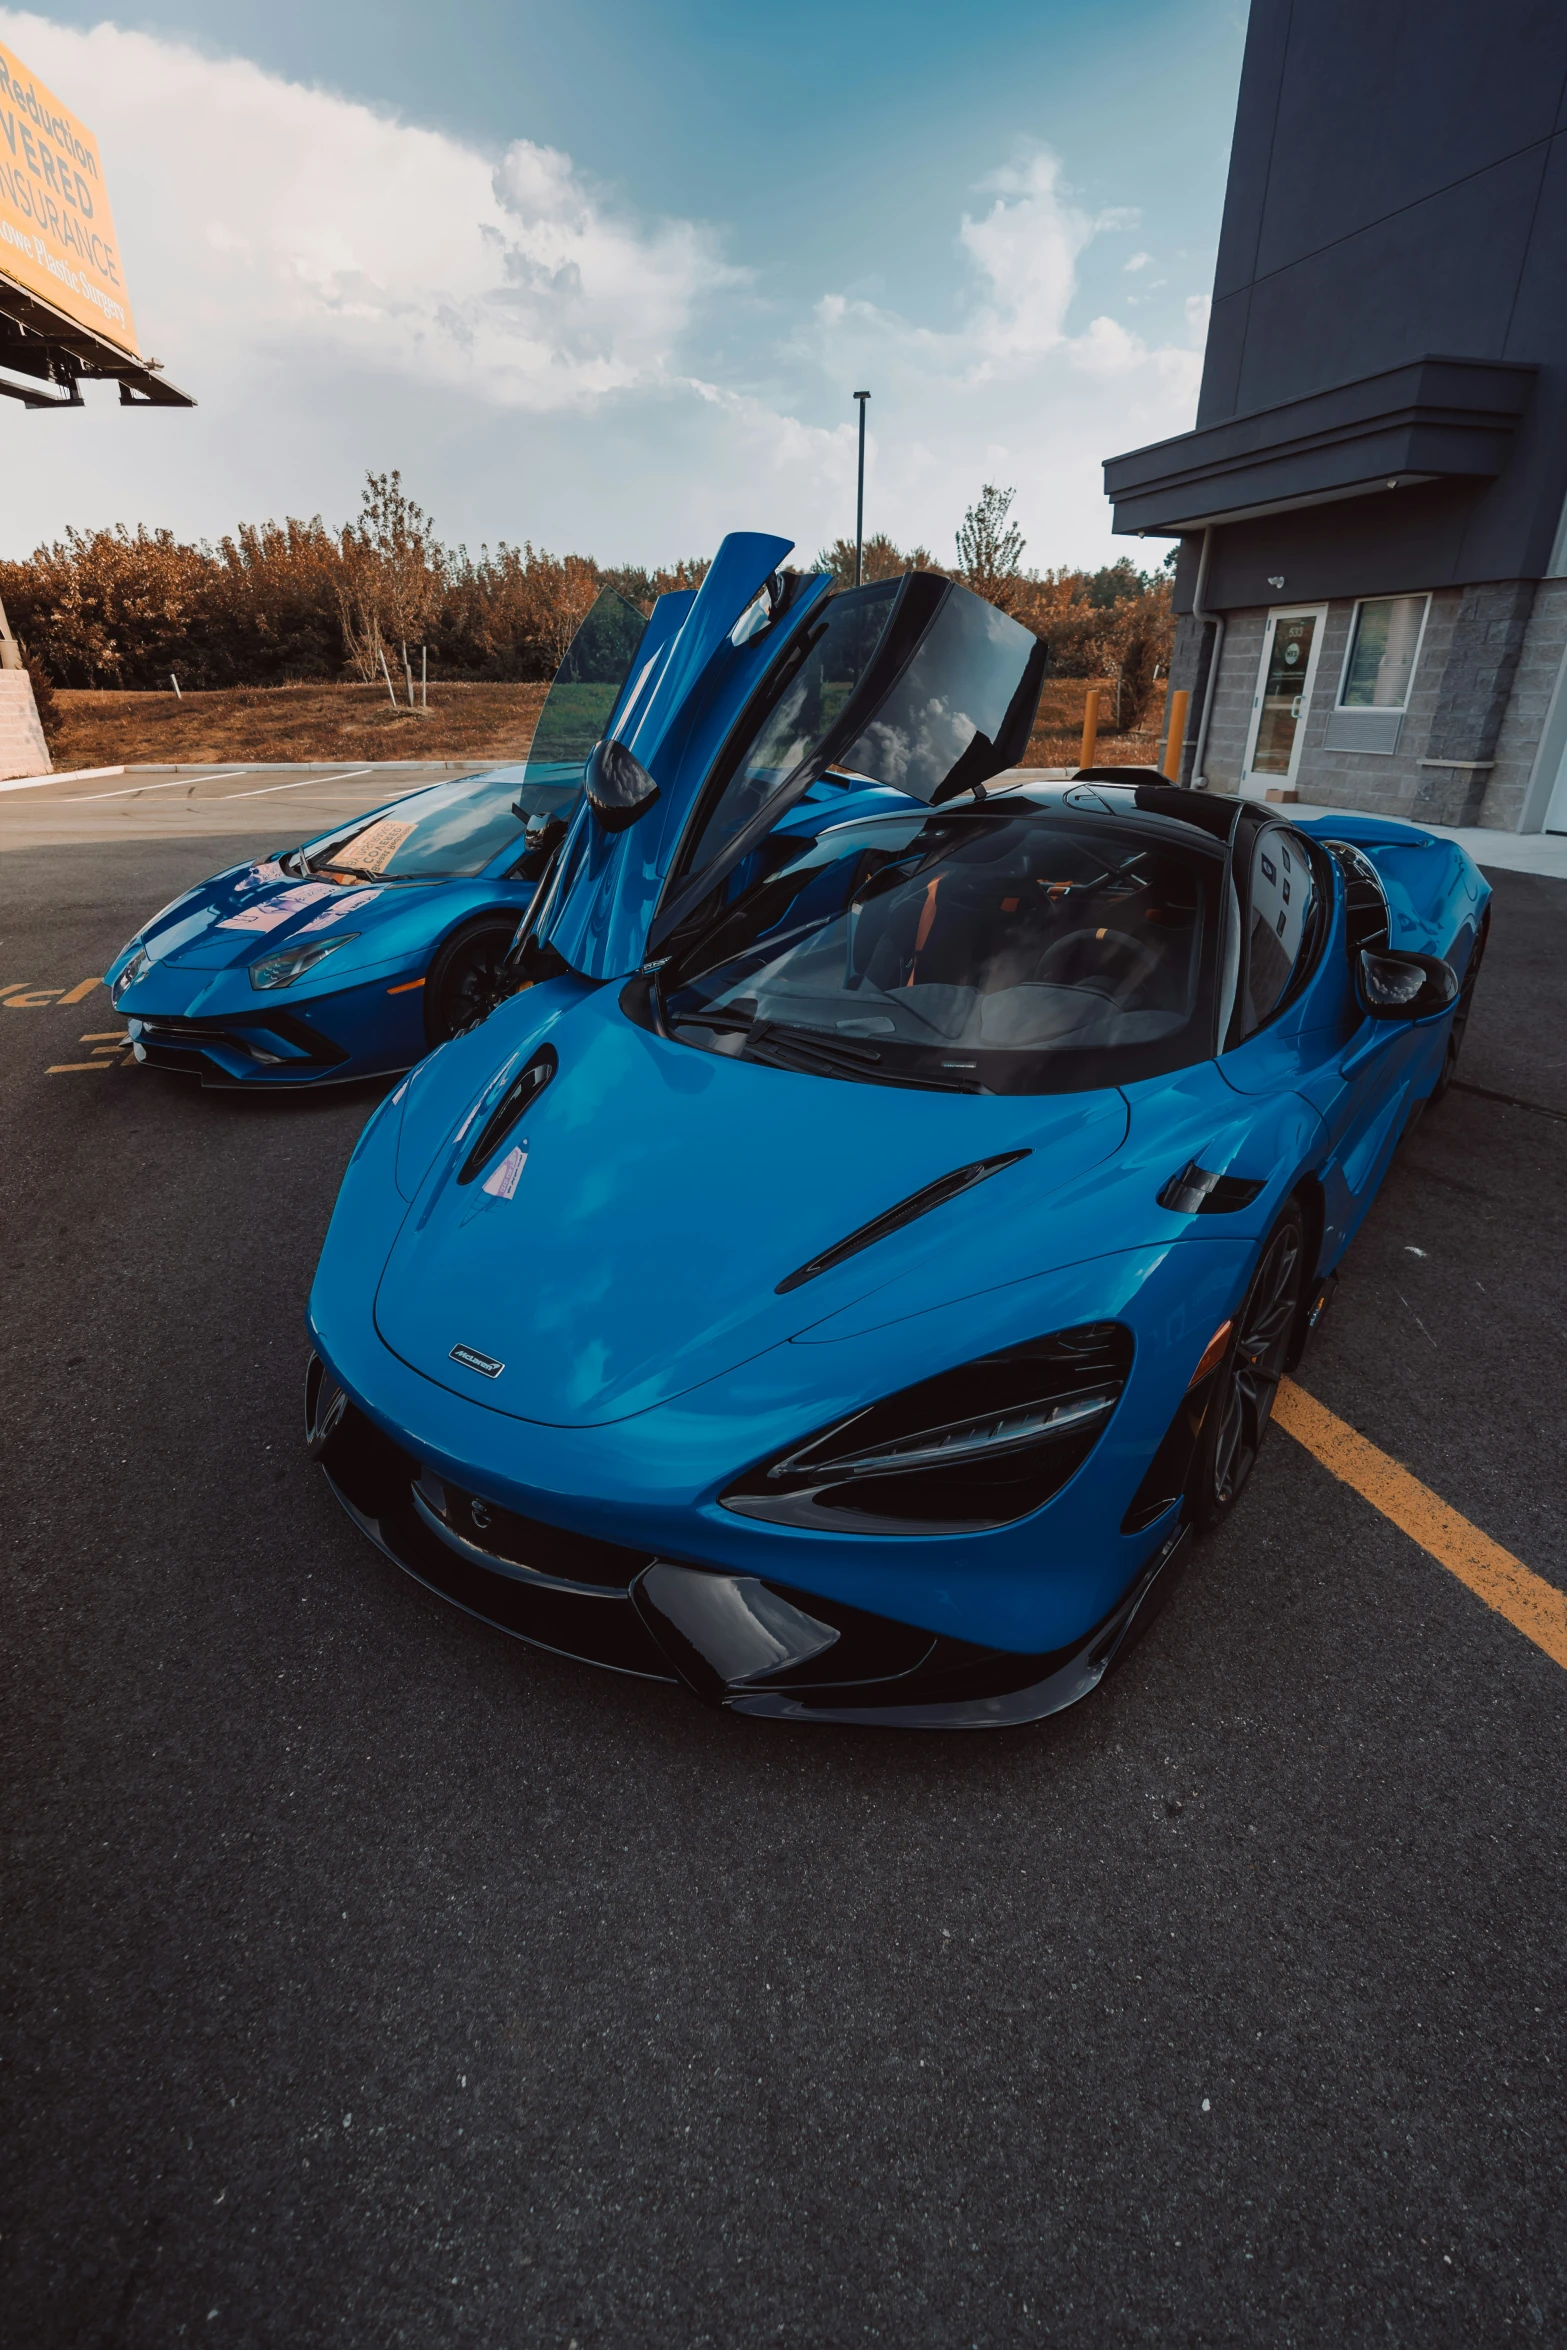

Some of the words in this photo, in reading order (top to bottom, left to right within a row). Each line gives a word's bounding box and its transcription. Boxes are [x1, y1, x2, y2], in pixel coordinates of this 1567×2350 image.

[0, 56, 98, 180] Reduction
[0, 220, 33, 258] owe
[32, 235, 80, 293] Plastic
[80, 271, 125, 330] Surgery
[1289, 627, 1303, 637] 533
[454, 1350, 493, 1371] McLaren
